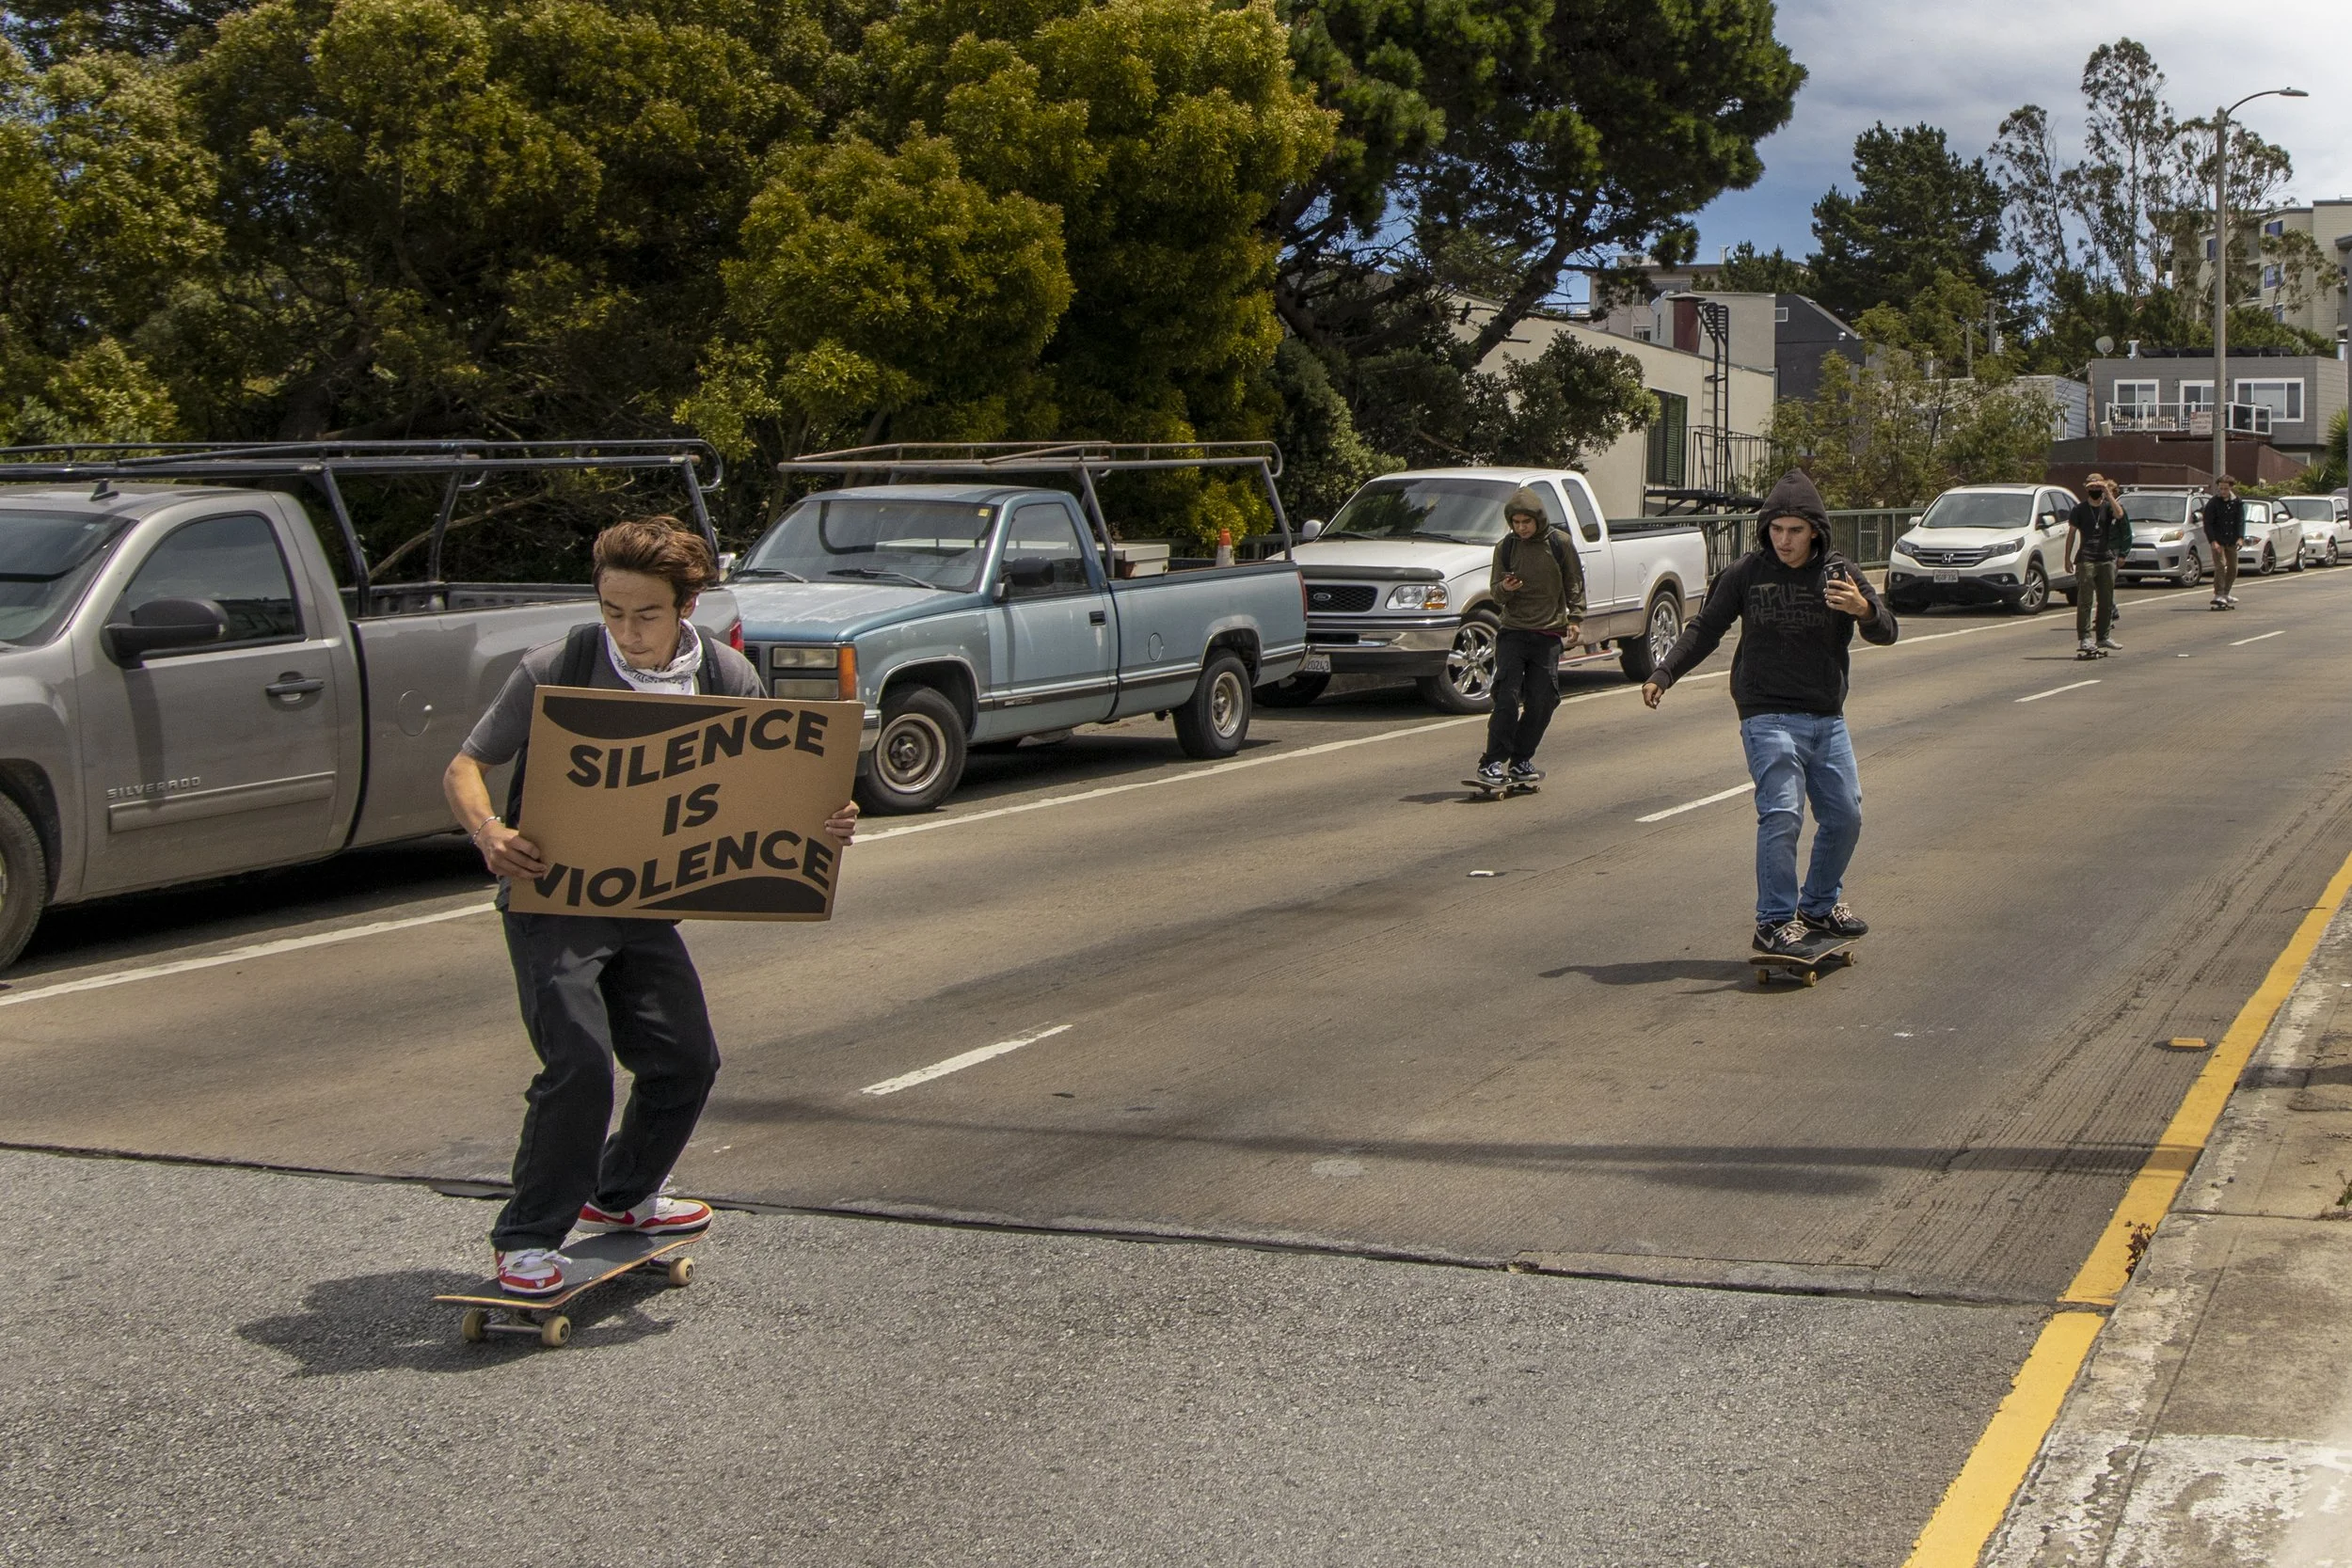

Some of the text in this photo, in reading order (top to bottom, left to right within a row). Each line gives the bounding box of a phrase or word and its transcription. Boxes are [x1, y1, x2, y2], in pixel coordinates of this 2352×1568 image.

[566, 709, 829, 788] SILENCE
[106, 776, 200, 799] SILVERADO
[662, 784, 721, 837] IS
[532, 830, 834, 908] VIOLENCE
